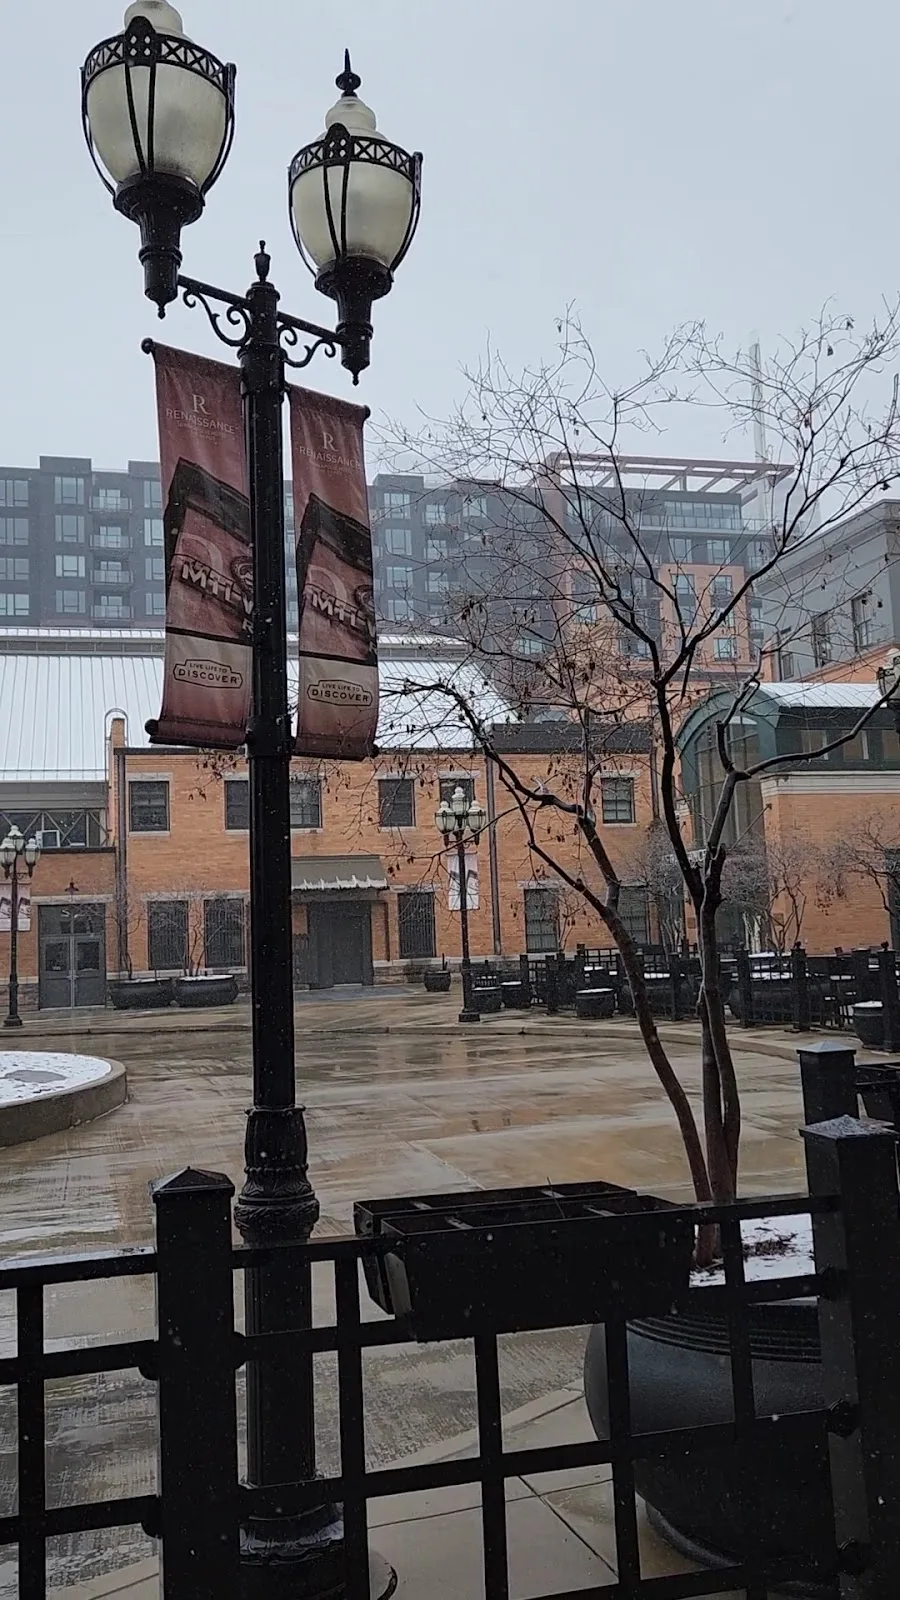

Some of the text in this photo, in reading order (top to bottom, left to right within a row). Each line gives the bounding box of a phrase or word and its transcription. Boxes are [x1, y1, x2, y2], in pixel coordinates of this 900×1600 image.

[192, 393, 212, 415] R
[166, 408, 236, 435] RENAISSANCE
[322, 431, 340, 452] R
[189, 662, 204, 670] LIVE
[178, 668, 238, 684] DISCOVER
[321, 682, 336, 690] LIVE
[312, 688, 369, 702] DISCOVER
